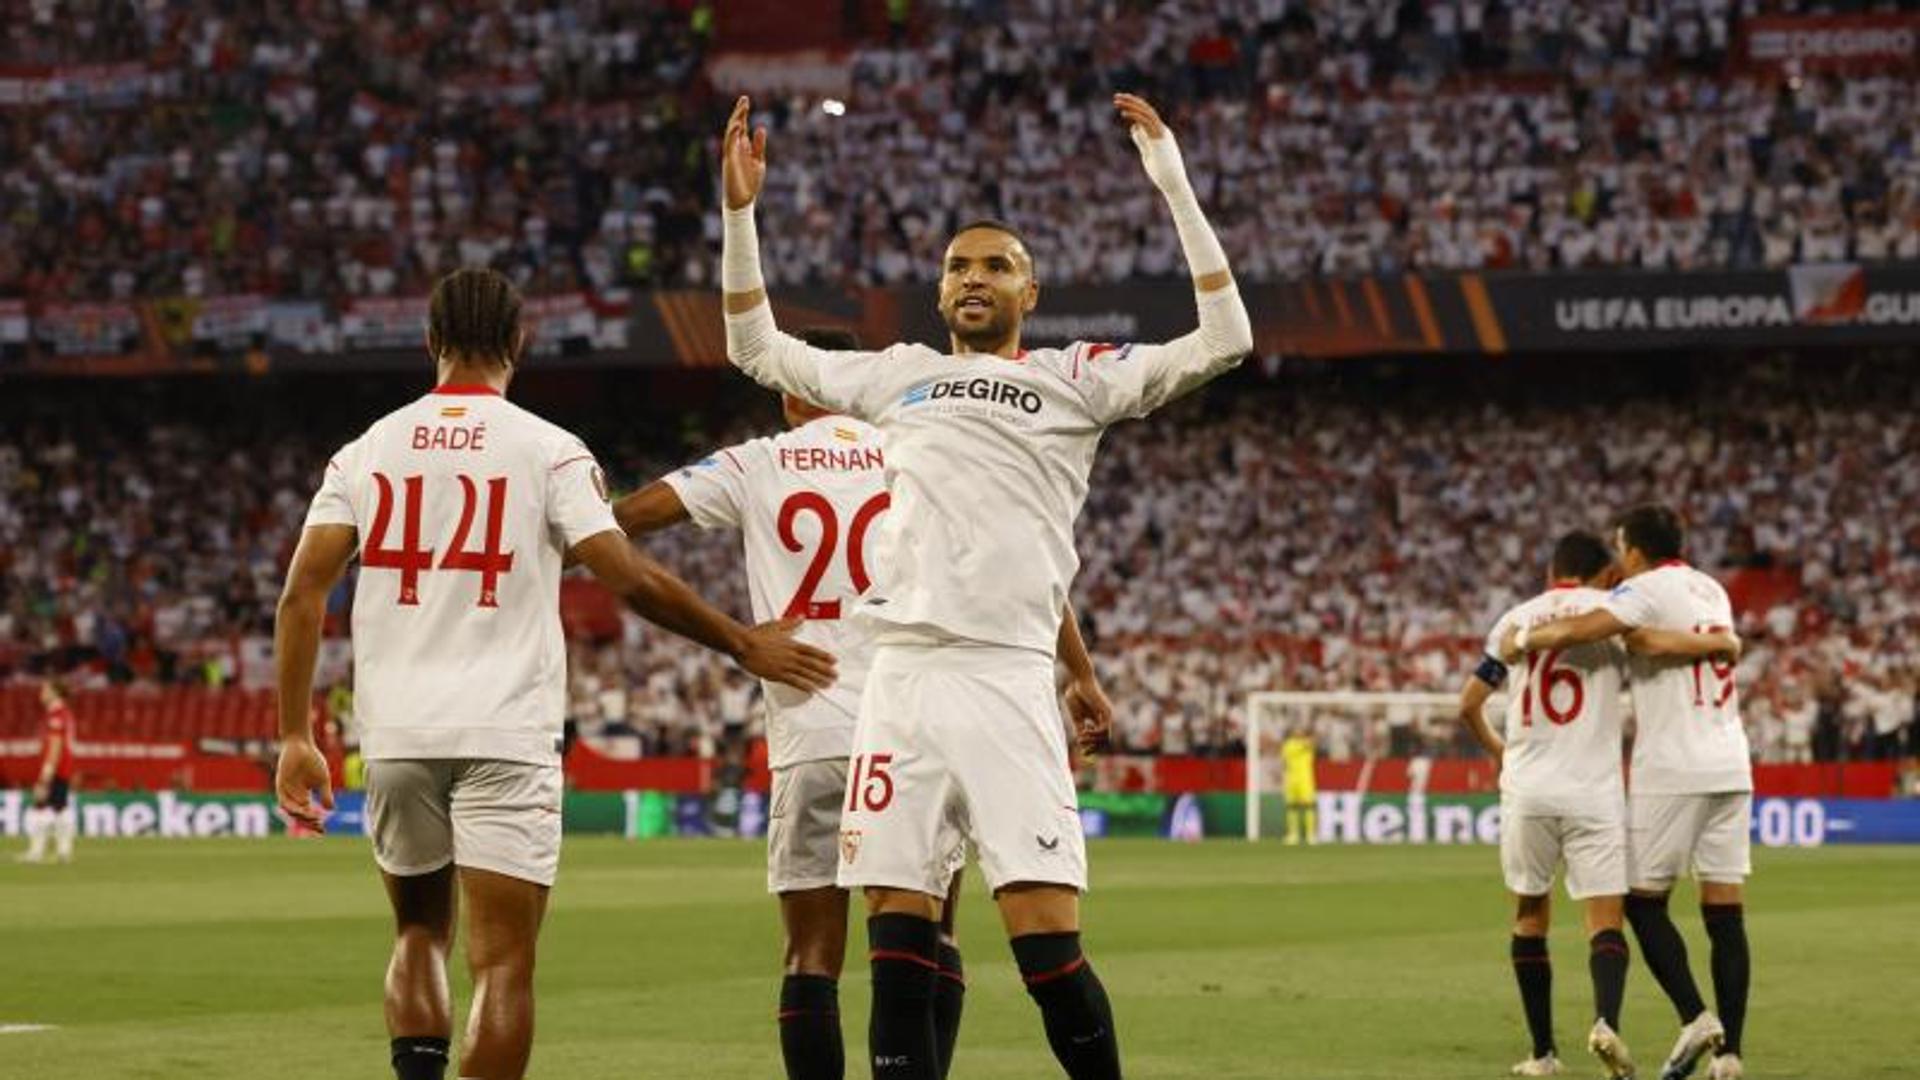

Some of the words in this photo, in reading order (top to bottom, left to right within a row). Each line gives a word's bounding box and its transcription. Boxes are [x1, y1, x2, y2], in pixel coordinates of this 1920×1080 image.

[1789, 28, 1915, 56] DEGIRO
[1555, 299, 1647, 330] UEFA
[1654, 296, 1791, 328] EUROPA
[931, 378, 1042, 414] DEGIRO
[412, 422, 486, 450] BADÉ
[780, 448, 884, 471] FERNAN
[362, 472, 515, 608] 44
[1521, 650, 1584, 727] 16
[849, 754, 894, 812] 15
